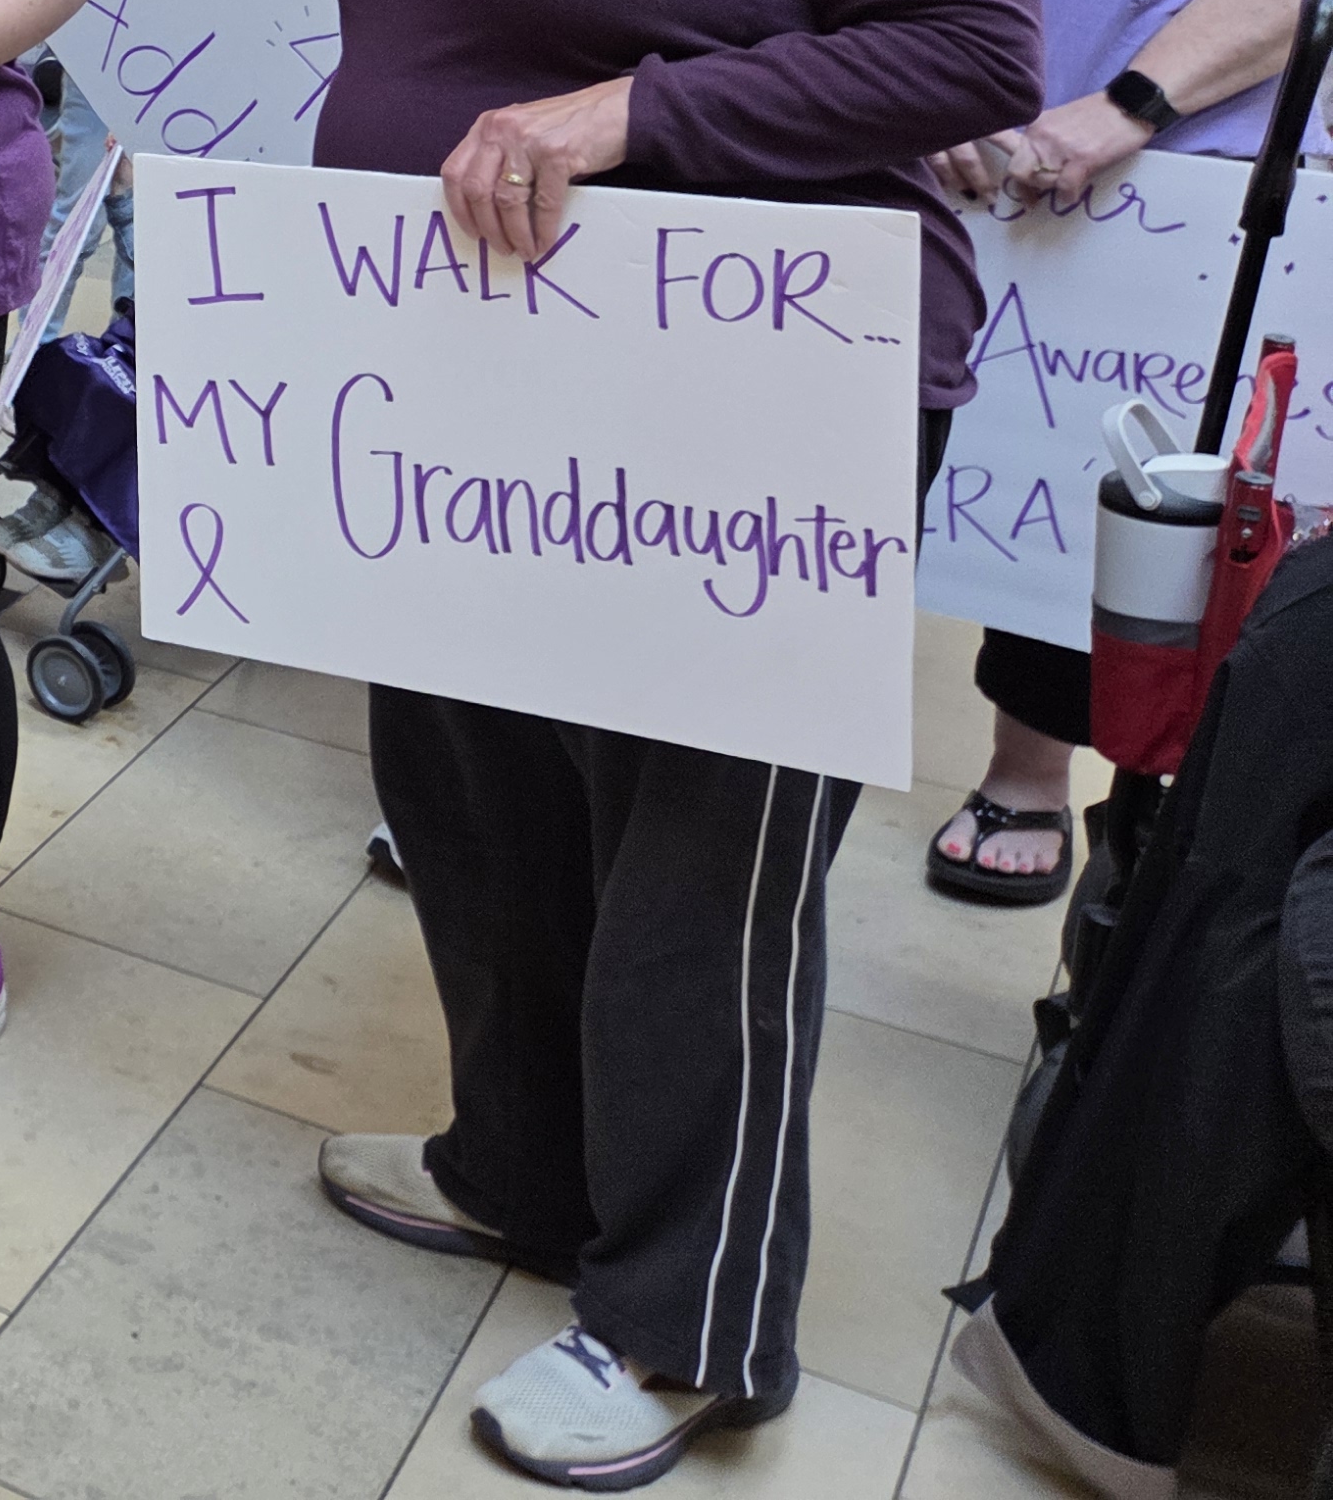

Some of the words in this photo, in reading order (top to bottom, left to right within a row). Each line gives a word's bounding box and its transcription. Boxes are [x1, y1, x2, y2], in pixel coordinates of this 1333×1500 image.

[176, 186, 264, 305] I
[318, 201, 600, 319] WALK
[153, 374, 288, 466] MY
[331, 373, 909, 618] Granddaughter
